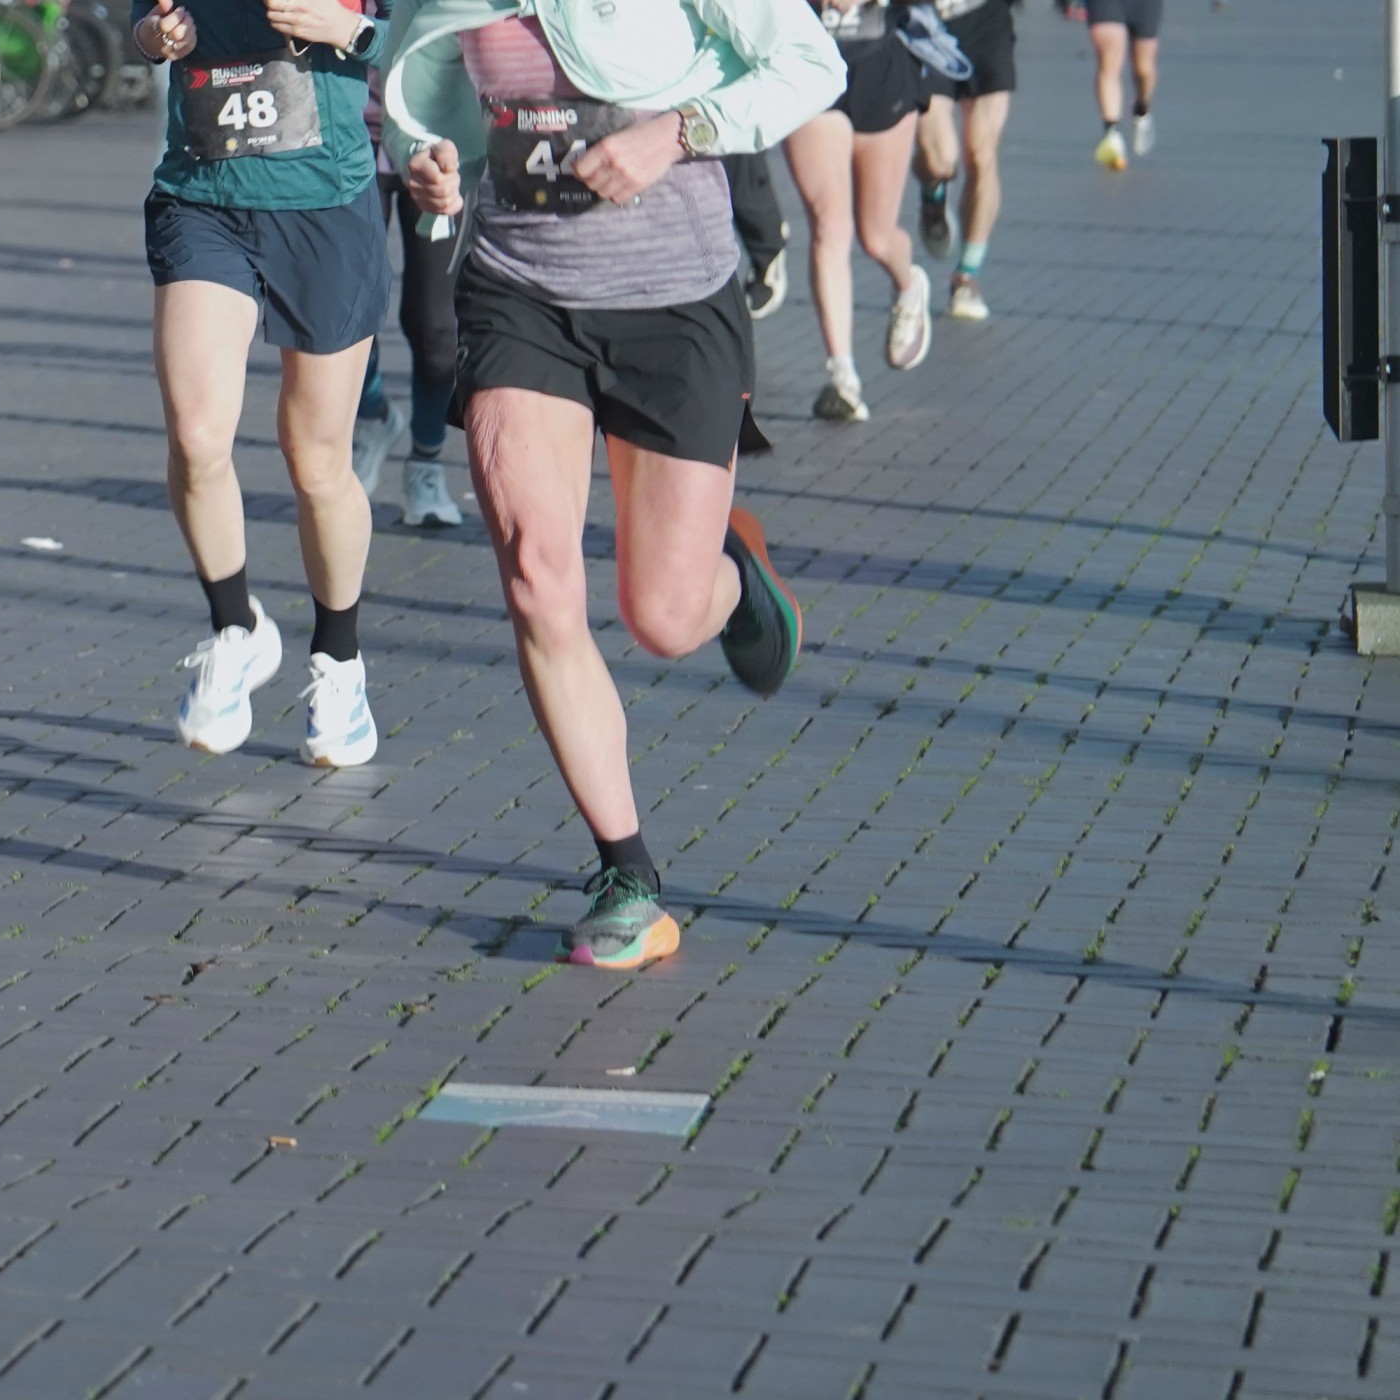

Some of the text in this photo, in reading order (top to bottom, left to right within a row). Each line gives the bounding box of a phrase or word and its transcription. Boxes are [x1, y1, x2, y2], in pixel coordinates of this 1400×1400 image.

[212, 64, 263, 79] RUNNING
[218, 90, 278, 130] 48
[517, 108, 578, 125] RUNNING
